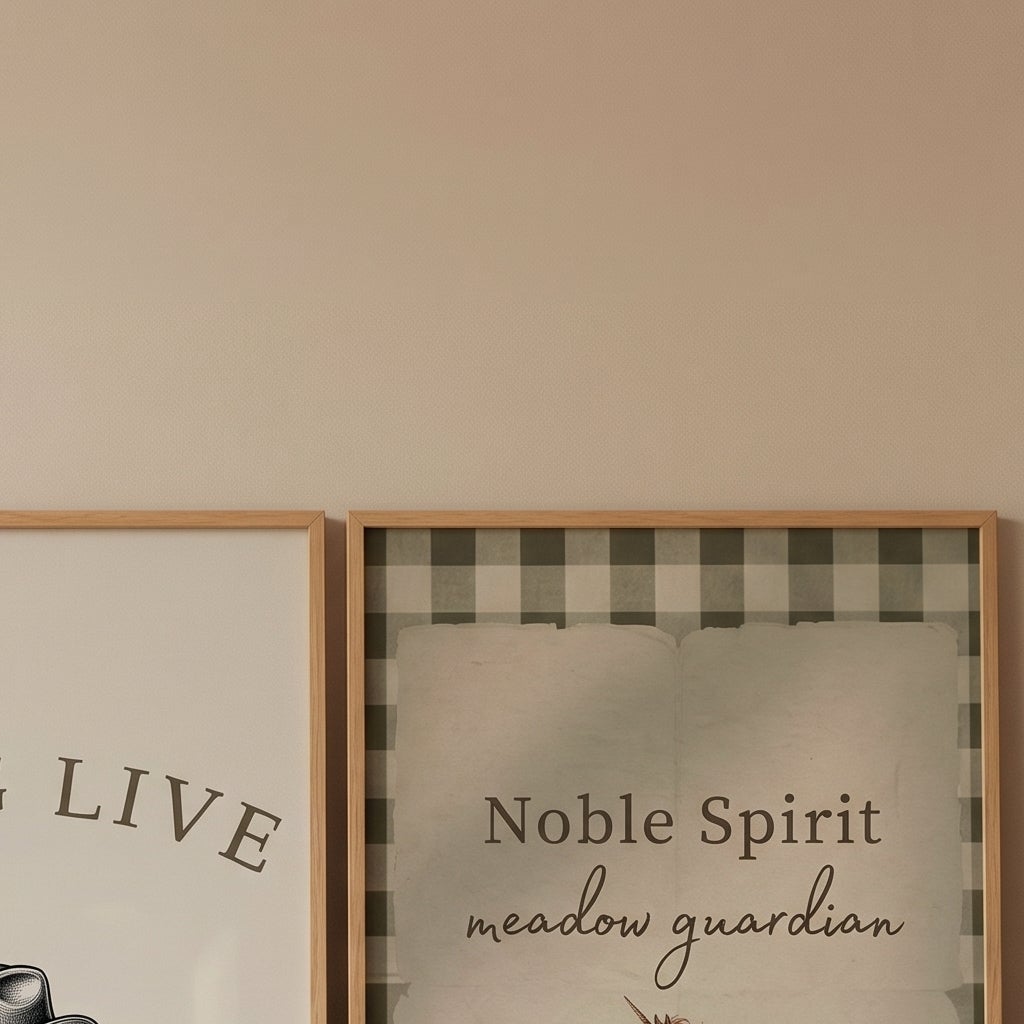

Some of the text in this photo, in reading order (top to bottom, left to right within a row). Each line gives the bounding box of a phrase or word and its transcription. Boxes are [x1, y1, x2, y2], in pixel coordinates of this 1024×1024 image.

[54, 756, 283, 874] LIVE
[484, 792, 882, 861] Noble Spirit
[466, 864, 904, 990] meadow guardian
